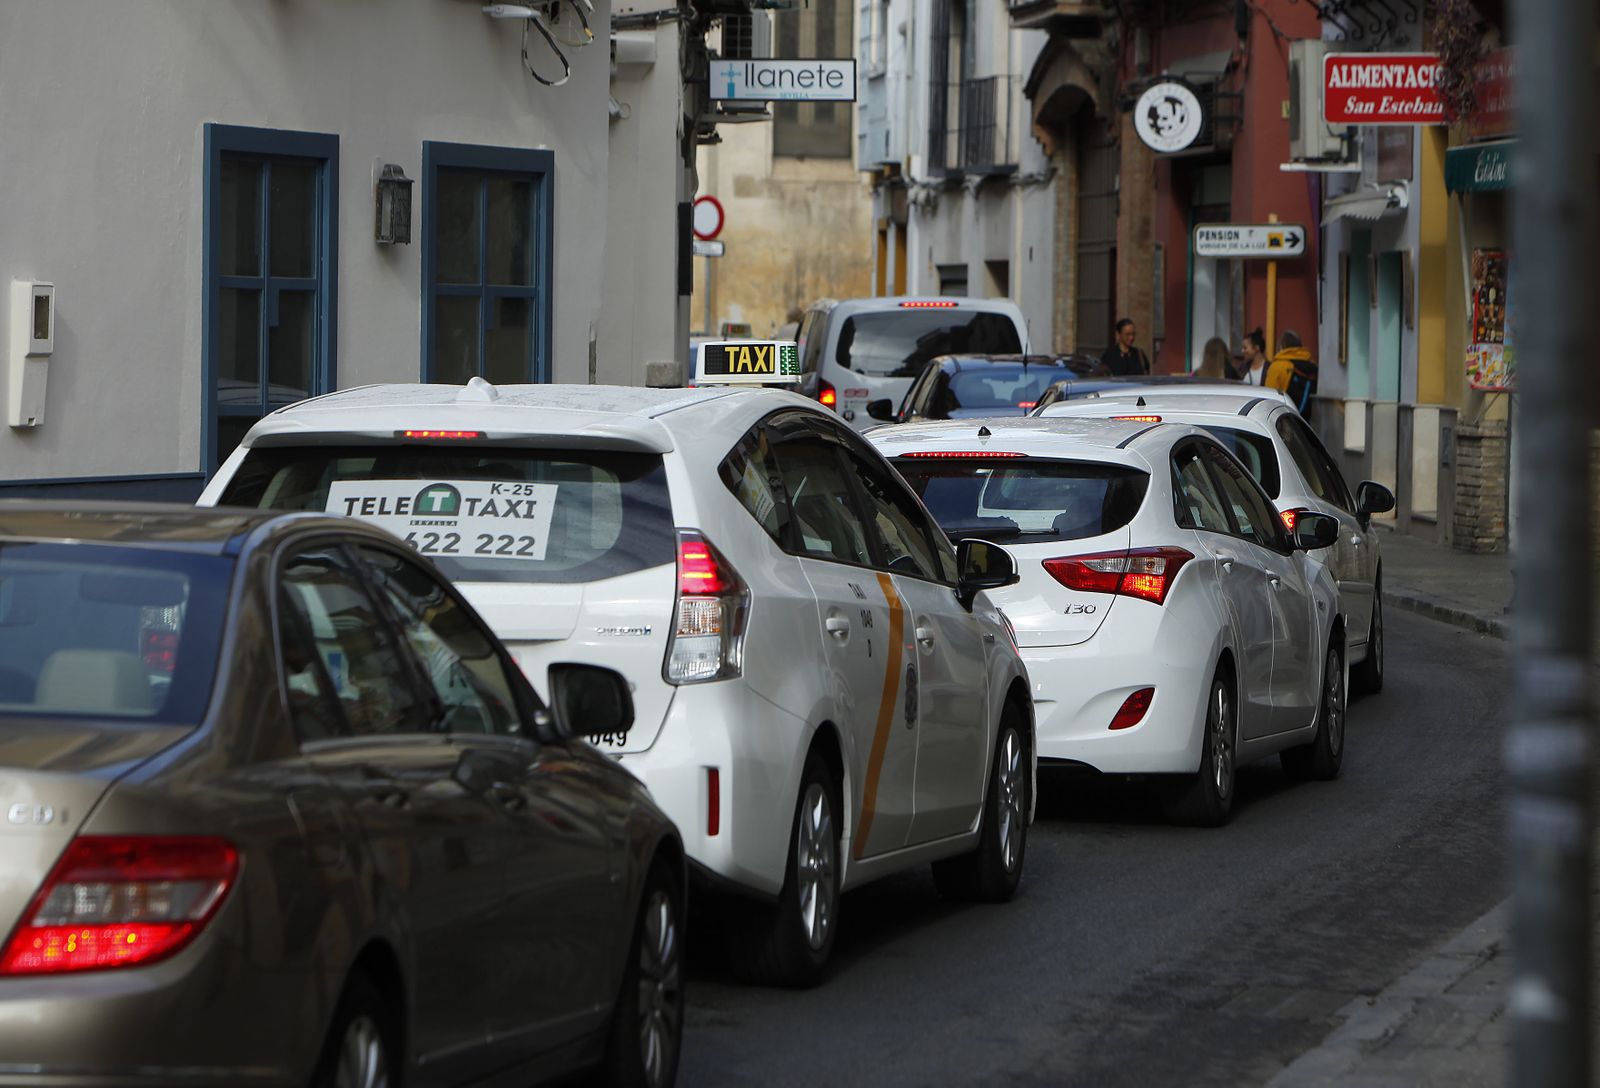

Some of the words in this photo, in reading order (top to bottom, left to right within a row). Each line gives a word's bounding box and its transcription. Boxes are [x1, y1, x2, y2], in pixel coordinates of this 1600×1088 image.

[745, 62, 844, 88] llanete
[1344, 96, 1375, 115] San
[1377, 95, 1444, 115] Esteban
[1199, 229, 1240, 240] PENSION
[724, 345, 775, 373] TAXI
[490, 482, 534, 496] K-25
[343, 496, 412, 517] TELE
[465, 497, 537, 519] TAXI
[474, 533, 536, 557] 222
[1063, 602, 1097, 615] i30
